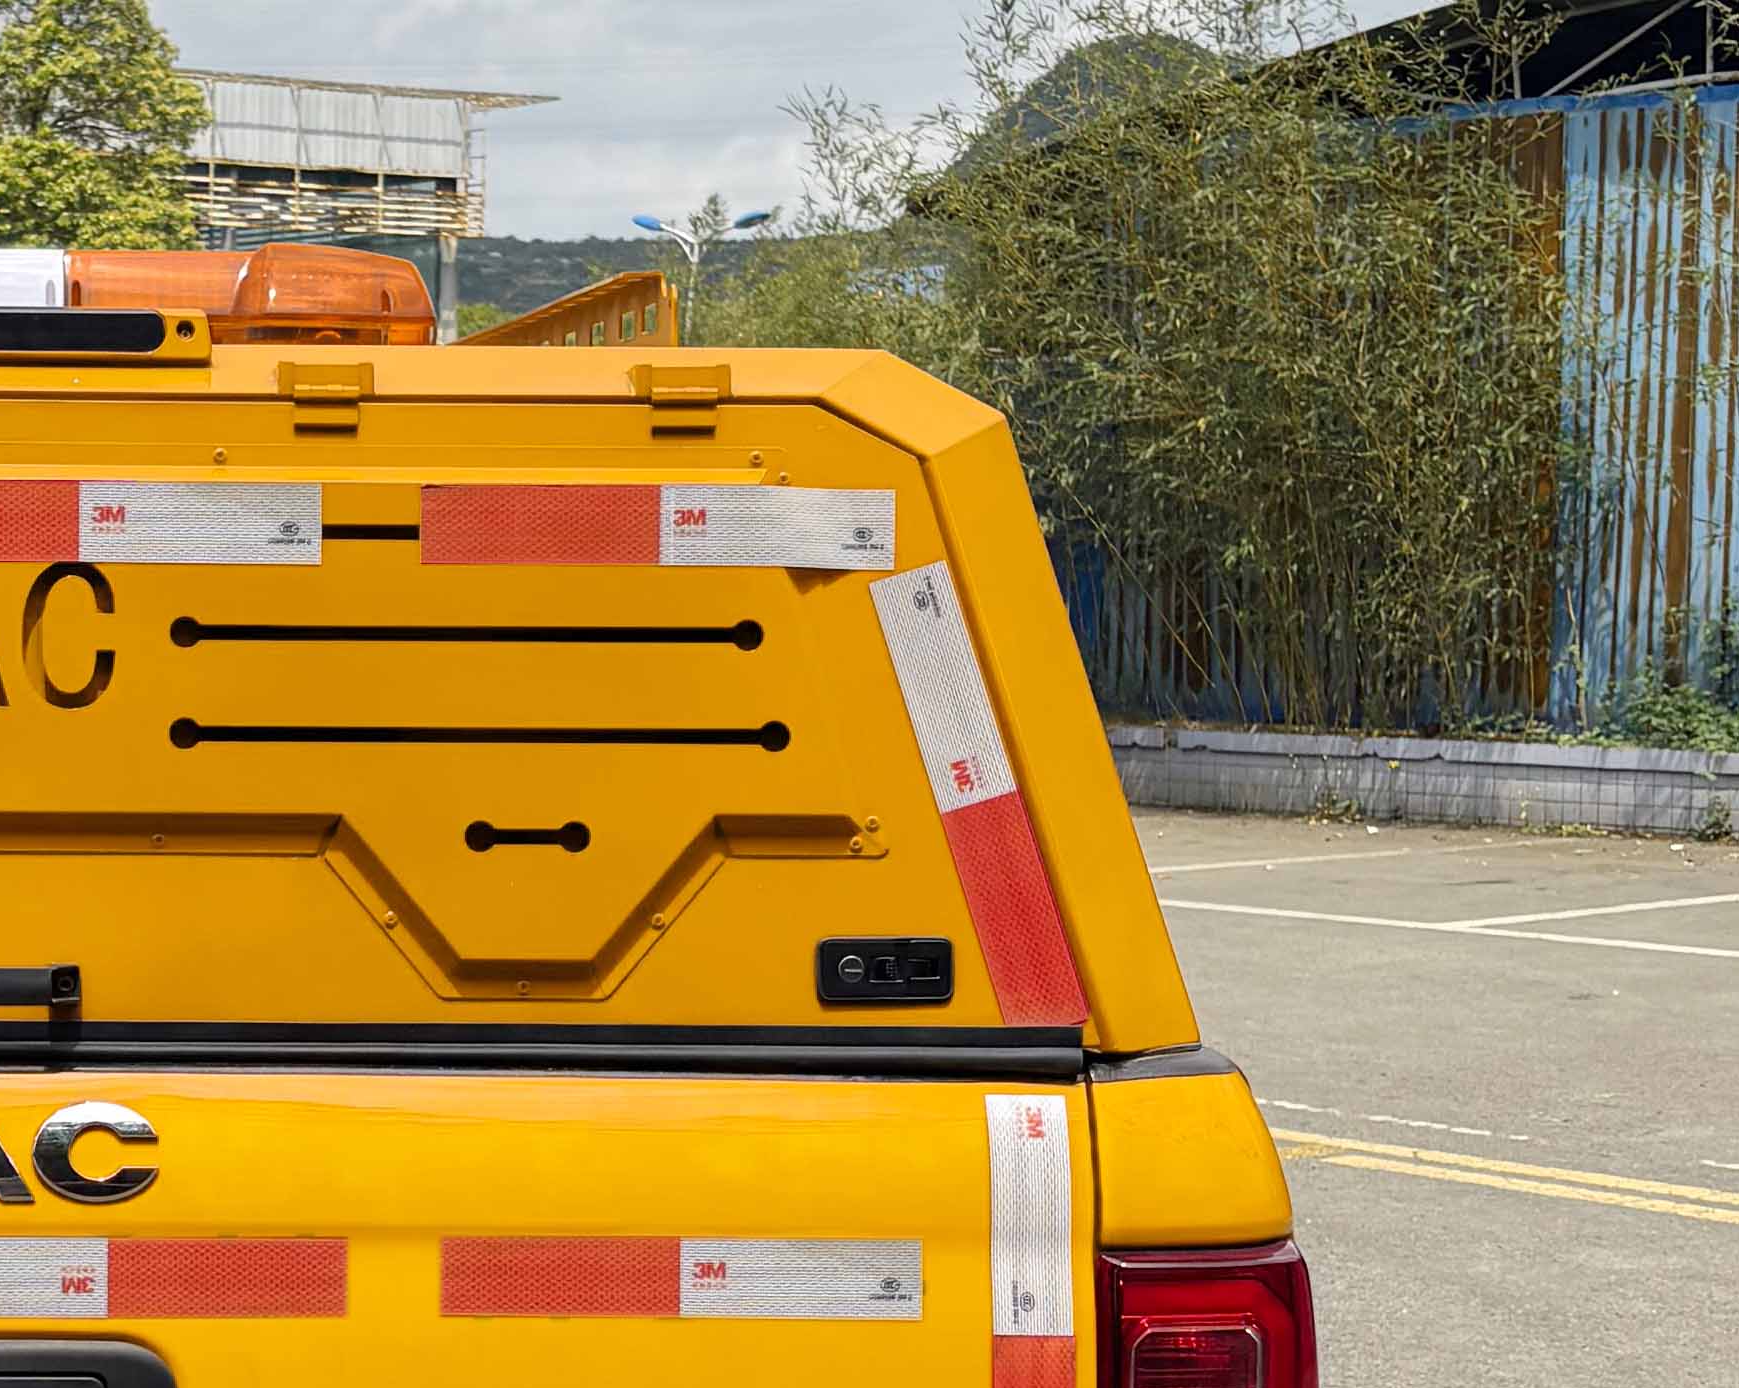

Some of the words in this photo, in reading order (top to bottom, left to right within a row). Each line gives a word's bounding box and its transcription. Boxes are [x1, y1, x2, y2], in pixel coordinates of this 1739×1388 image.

[92, 506, 126, 525] 3M
[673, 508, 707, 527] 3M
[949, 759, 975, 794] 3M
[1026, 1107, 1045, 1139] 3M
[693, 1262, 727, 1281] 3M
[61, 1275, 95, 1295] 3M
